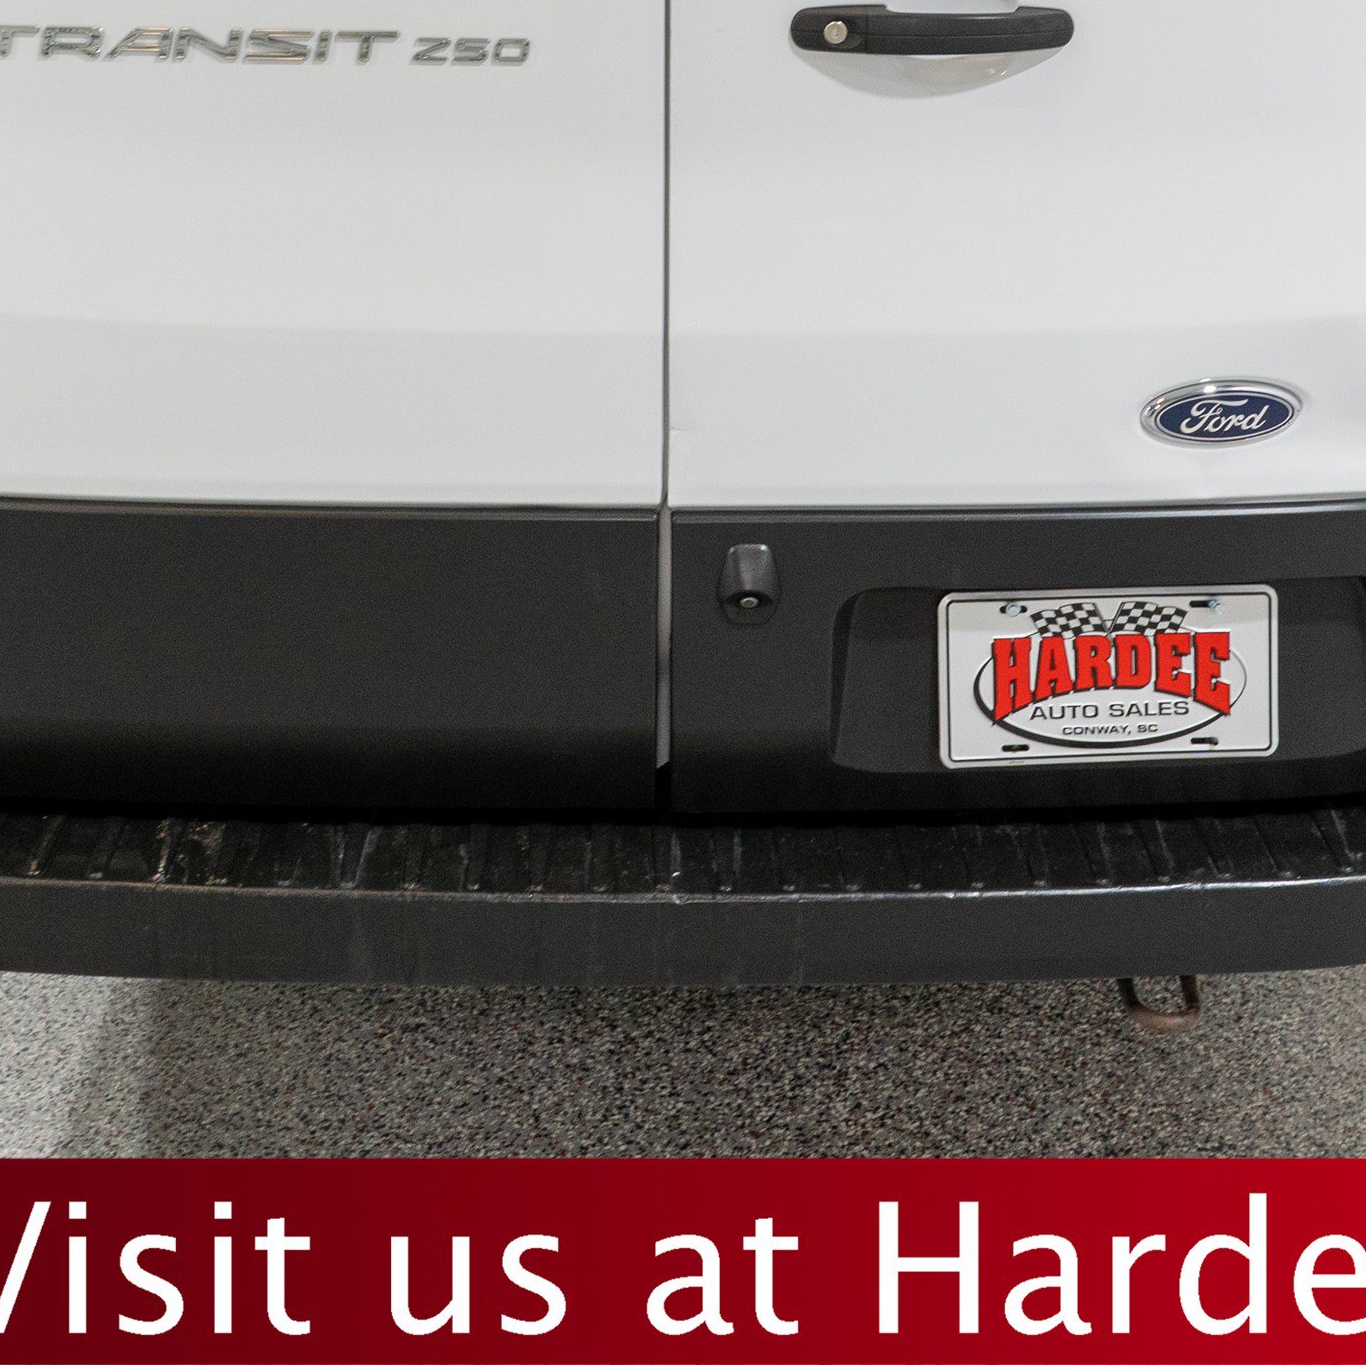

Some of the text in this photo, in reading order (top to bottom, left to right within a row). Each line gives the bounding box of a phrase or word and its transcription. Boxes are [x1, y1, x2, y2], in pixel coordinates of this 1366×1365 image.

[411, 37, 530, 65] 250
[1180, 398, 1269, 434] Ford
[992, 632, 1231, 724] HARDEE
[1030, 701, 1190, 720] AUTO SALES
[1062, 723, 1159, 736] CONWAY, SC
